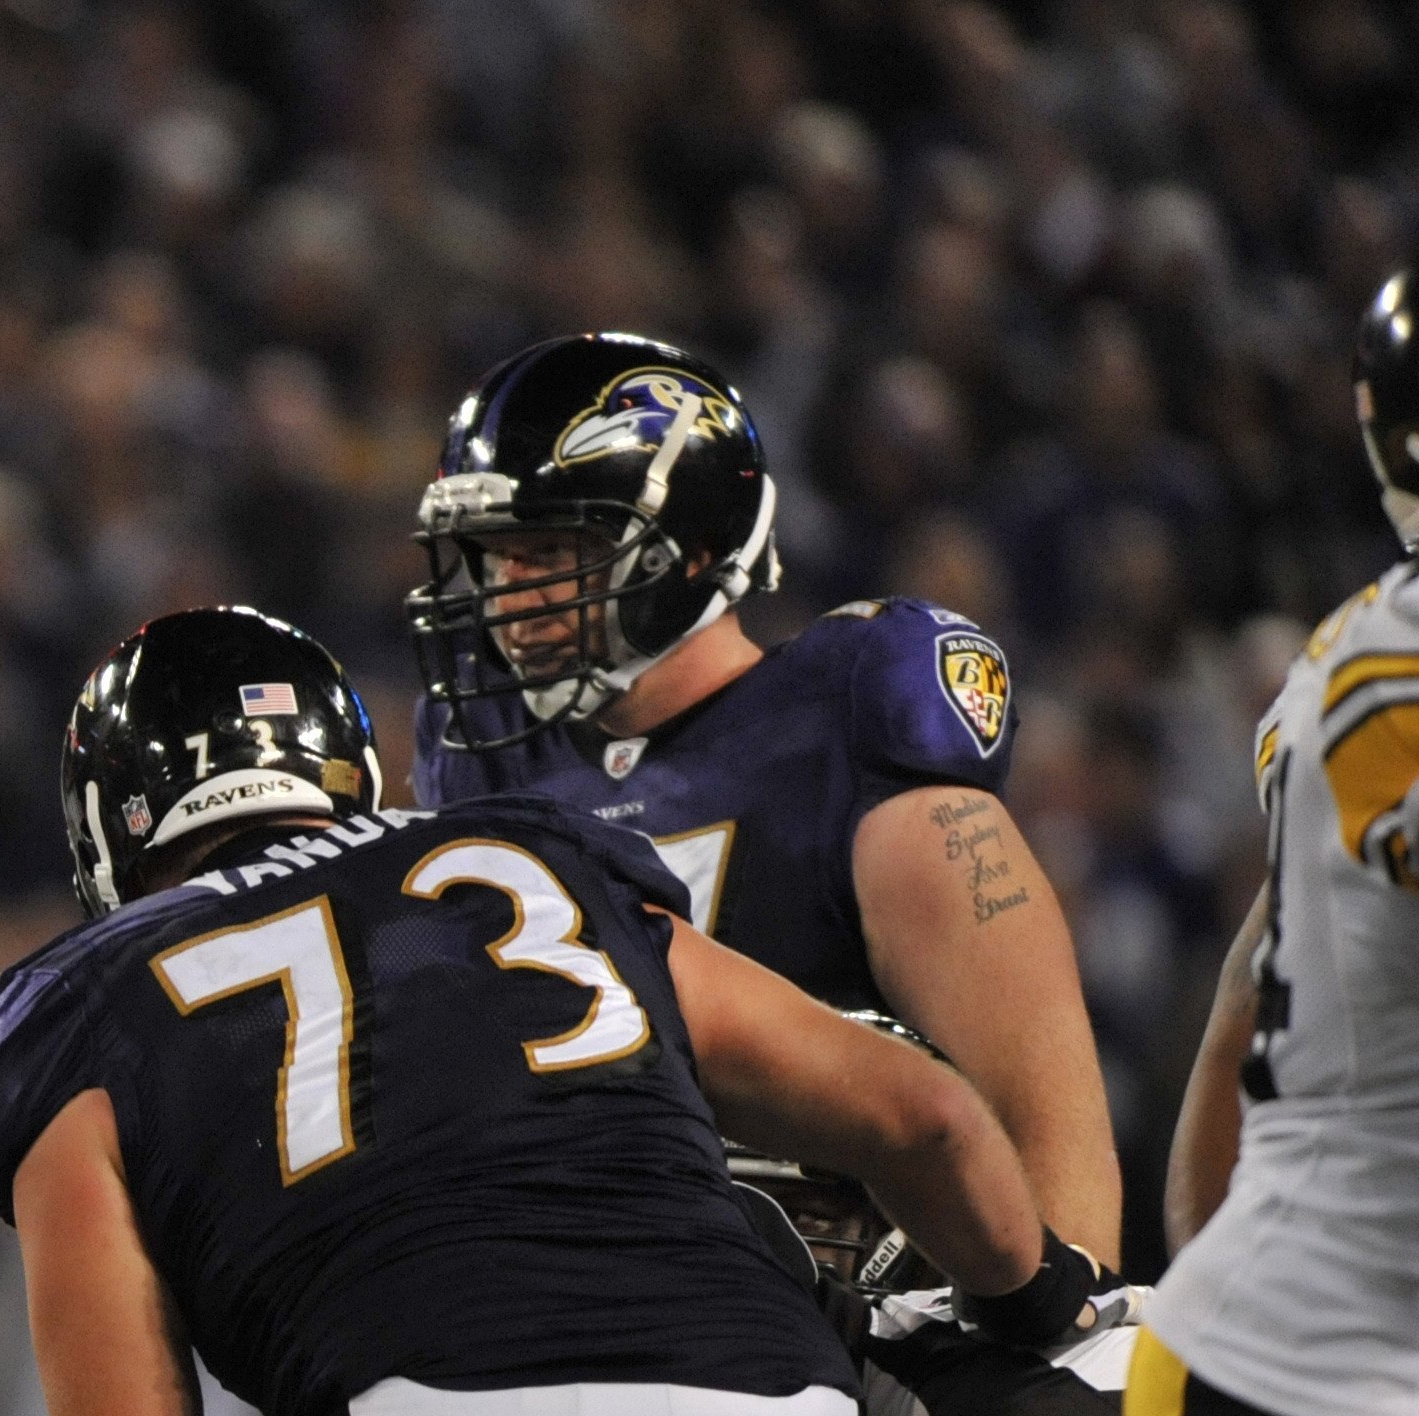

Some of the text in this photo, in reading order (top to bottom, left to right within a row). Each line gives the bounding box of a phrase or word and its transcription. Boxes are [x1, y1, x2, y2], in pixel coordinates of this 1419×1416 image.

[945, 638, 1001, 662] RAVENS
[179, 778, 295, 817] RAVENS
[149, 838, 651, 1188] 73
[863, 1240, 900, 1285] ddell
